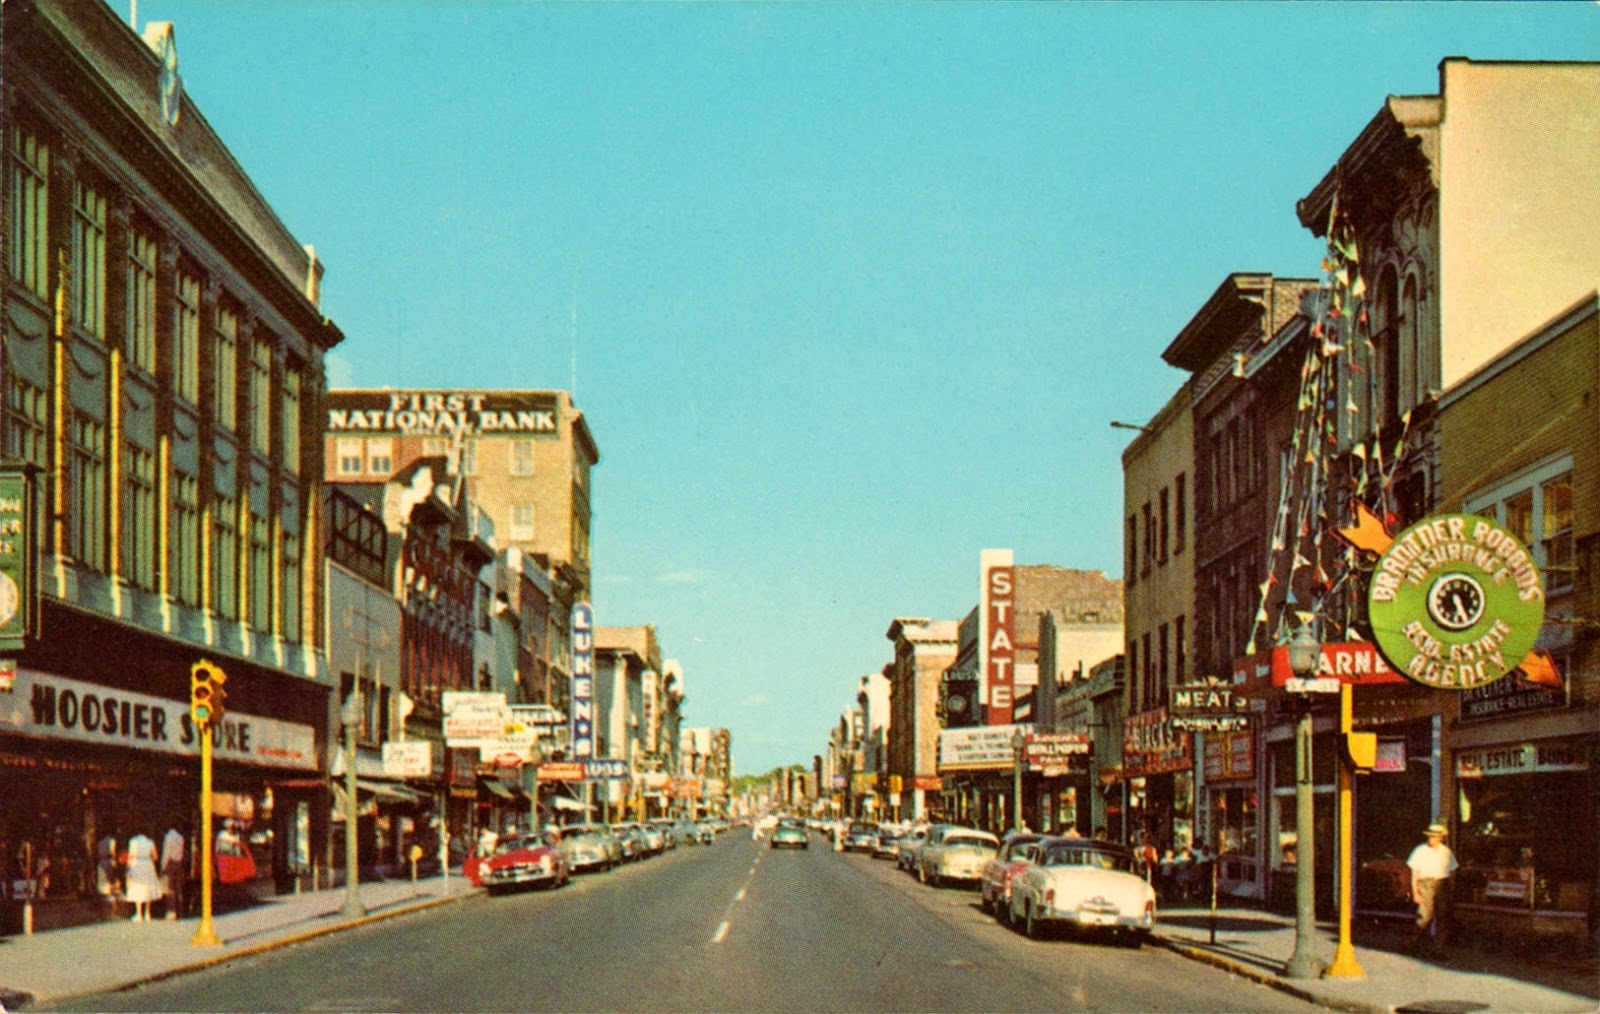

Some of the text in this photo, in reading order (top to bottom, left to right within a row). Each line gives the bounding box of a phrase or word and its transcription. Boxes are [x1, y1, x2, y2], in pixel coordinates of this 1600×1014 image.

[328, 410, 555, 430] NATIONAL BANK
[390, 394, 486, 412] FIRST
[1405, 542, 1510, 586] INSURANCE
[991, 571, 1012, 708] STATE
[1408, 650, 1506, 687] AGENCY
[1176, 691, 1247, 707] MEATS
[30, 683, 250, 753] HOOSIER SORE
